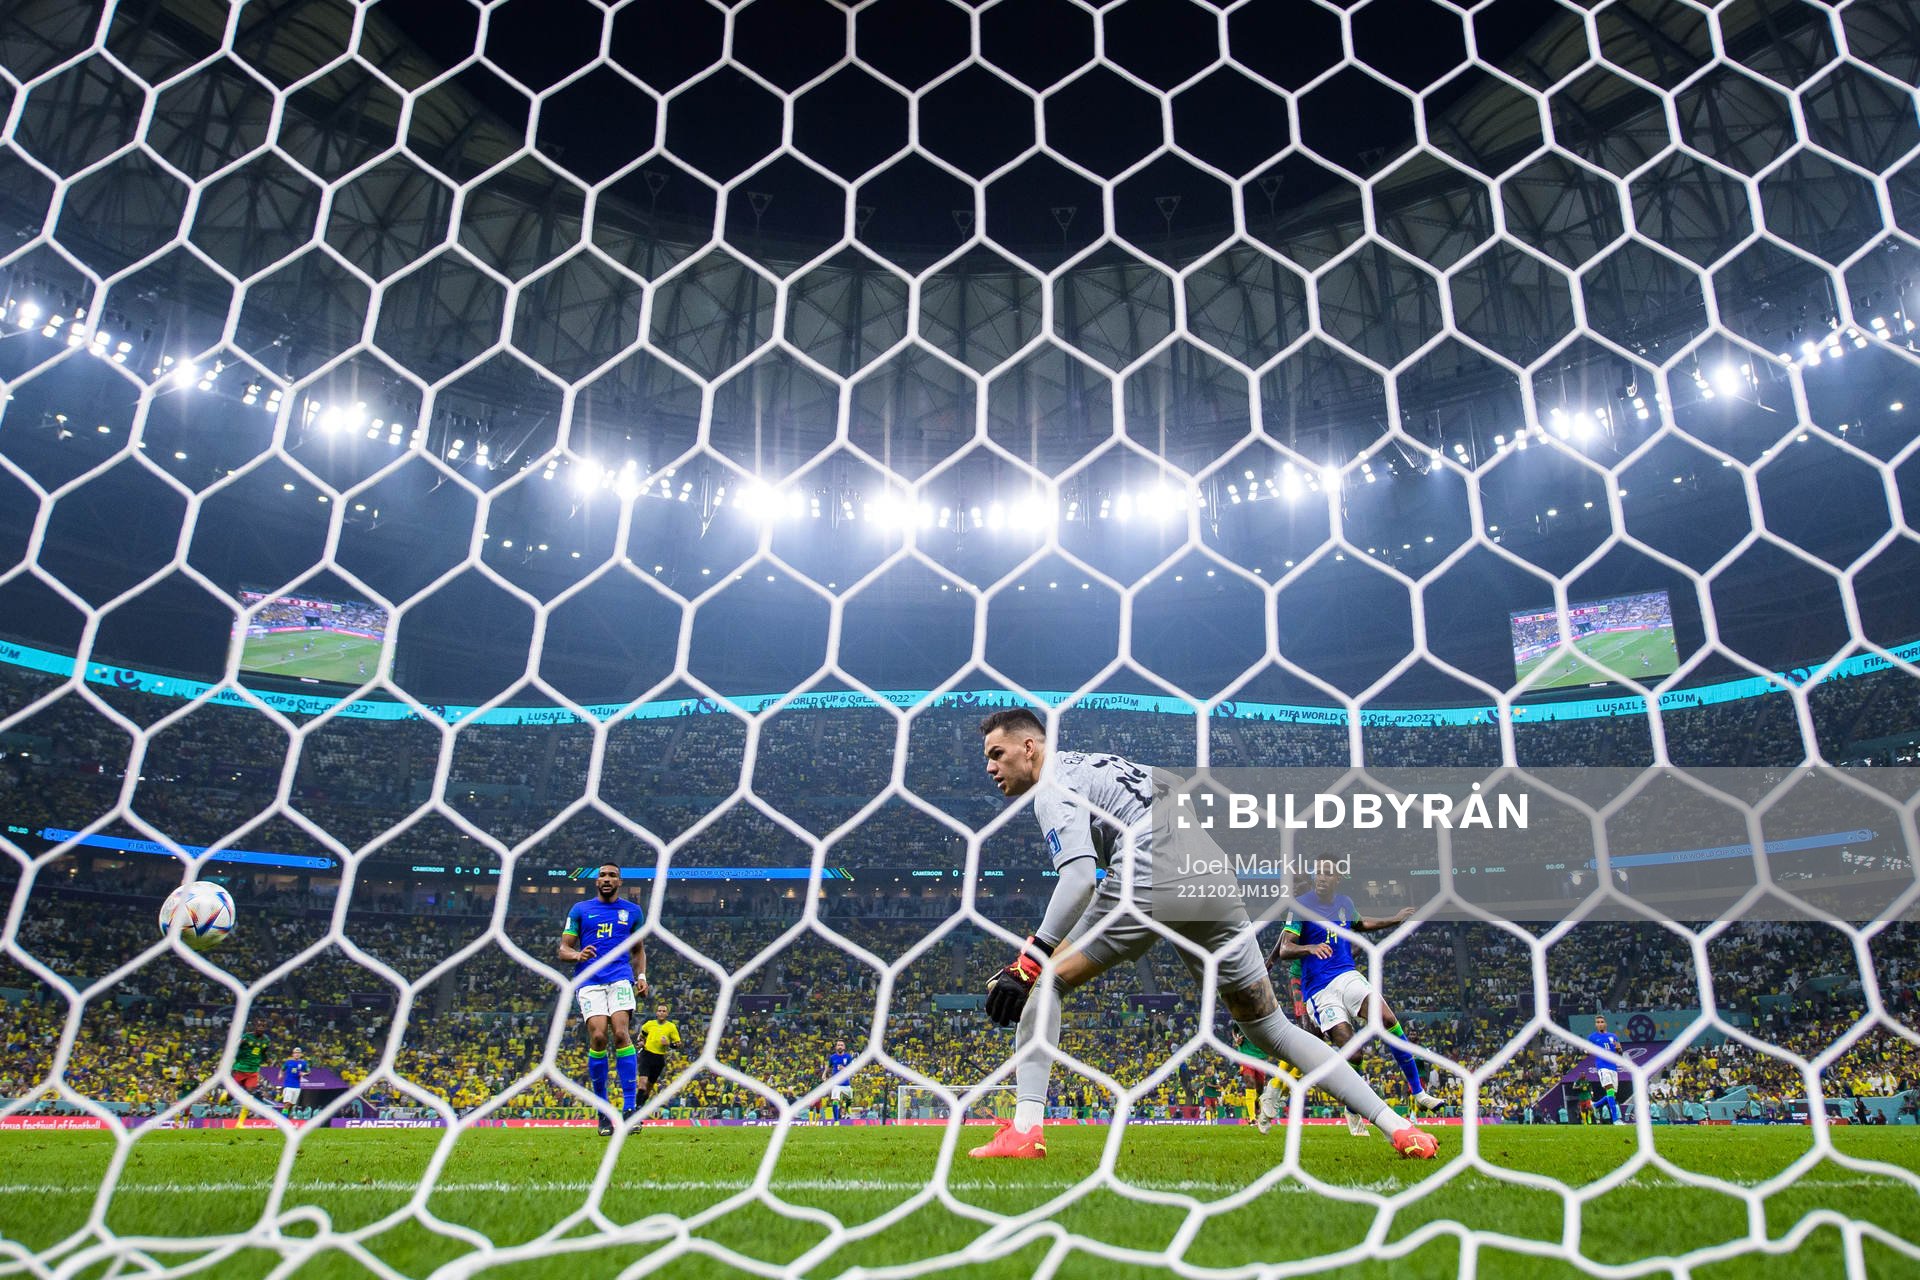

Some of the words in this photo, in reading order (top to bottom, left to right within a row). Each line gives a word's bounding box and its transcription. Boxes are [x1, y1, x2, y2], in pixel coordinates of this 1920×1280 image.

[1596, 701, 1639, 713] LUSAIL
[527, 711, 567, 721] LUSAIL
[1279, 709, 1300, 719] FIFA
[1301, 711, 1338, 721] WORLD
[454, 866, 462, 875] 0
[473, 867, 481, 876] 0
[952, 870, 959, 878] 0
[1451, 867, 1458, 875] 0
[1470, 866, 1477, 875] 0
[596, 922, 613, 939] 24
[616, 986, 632, 1001] 24
